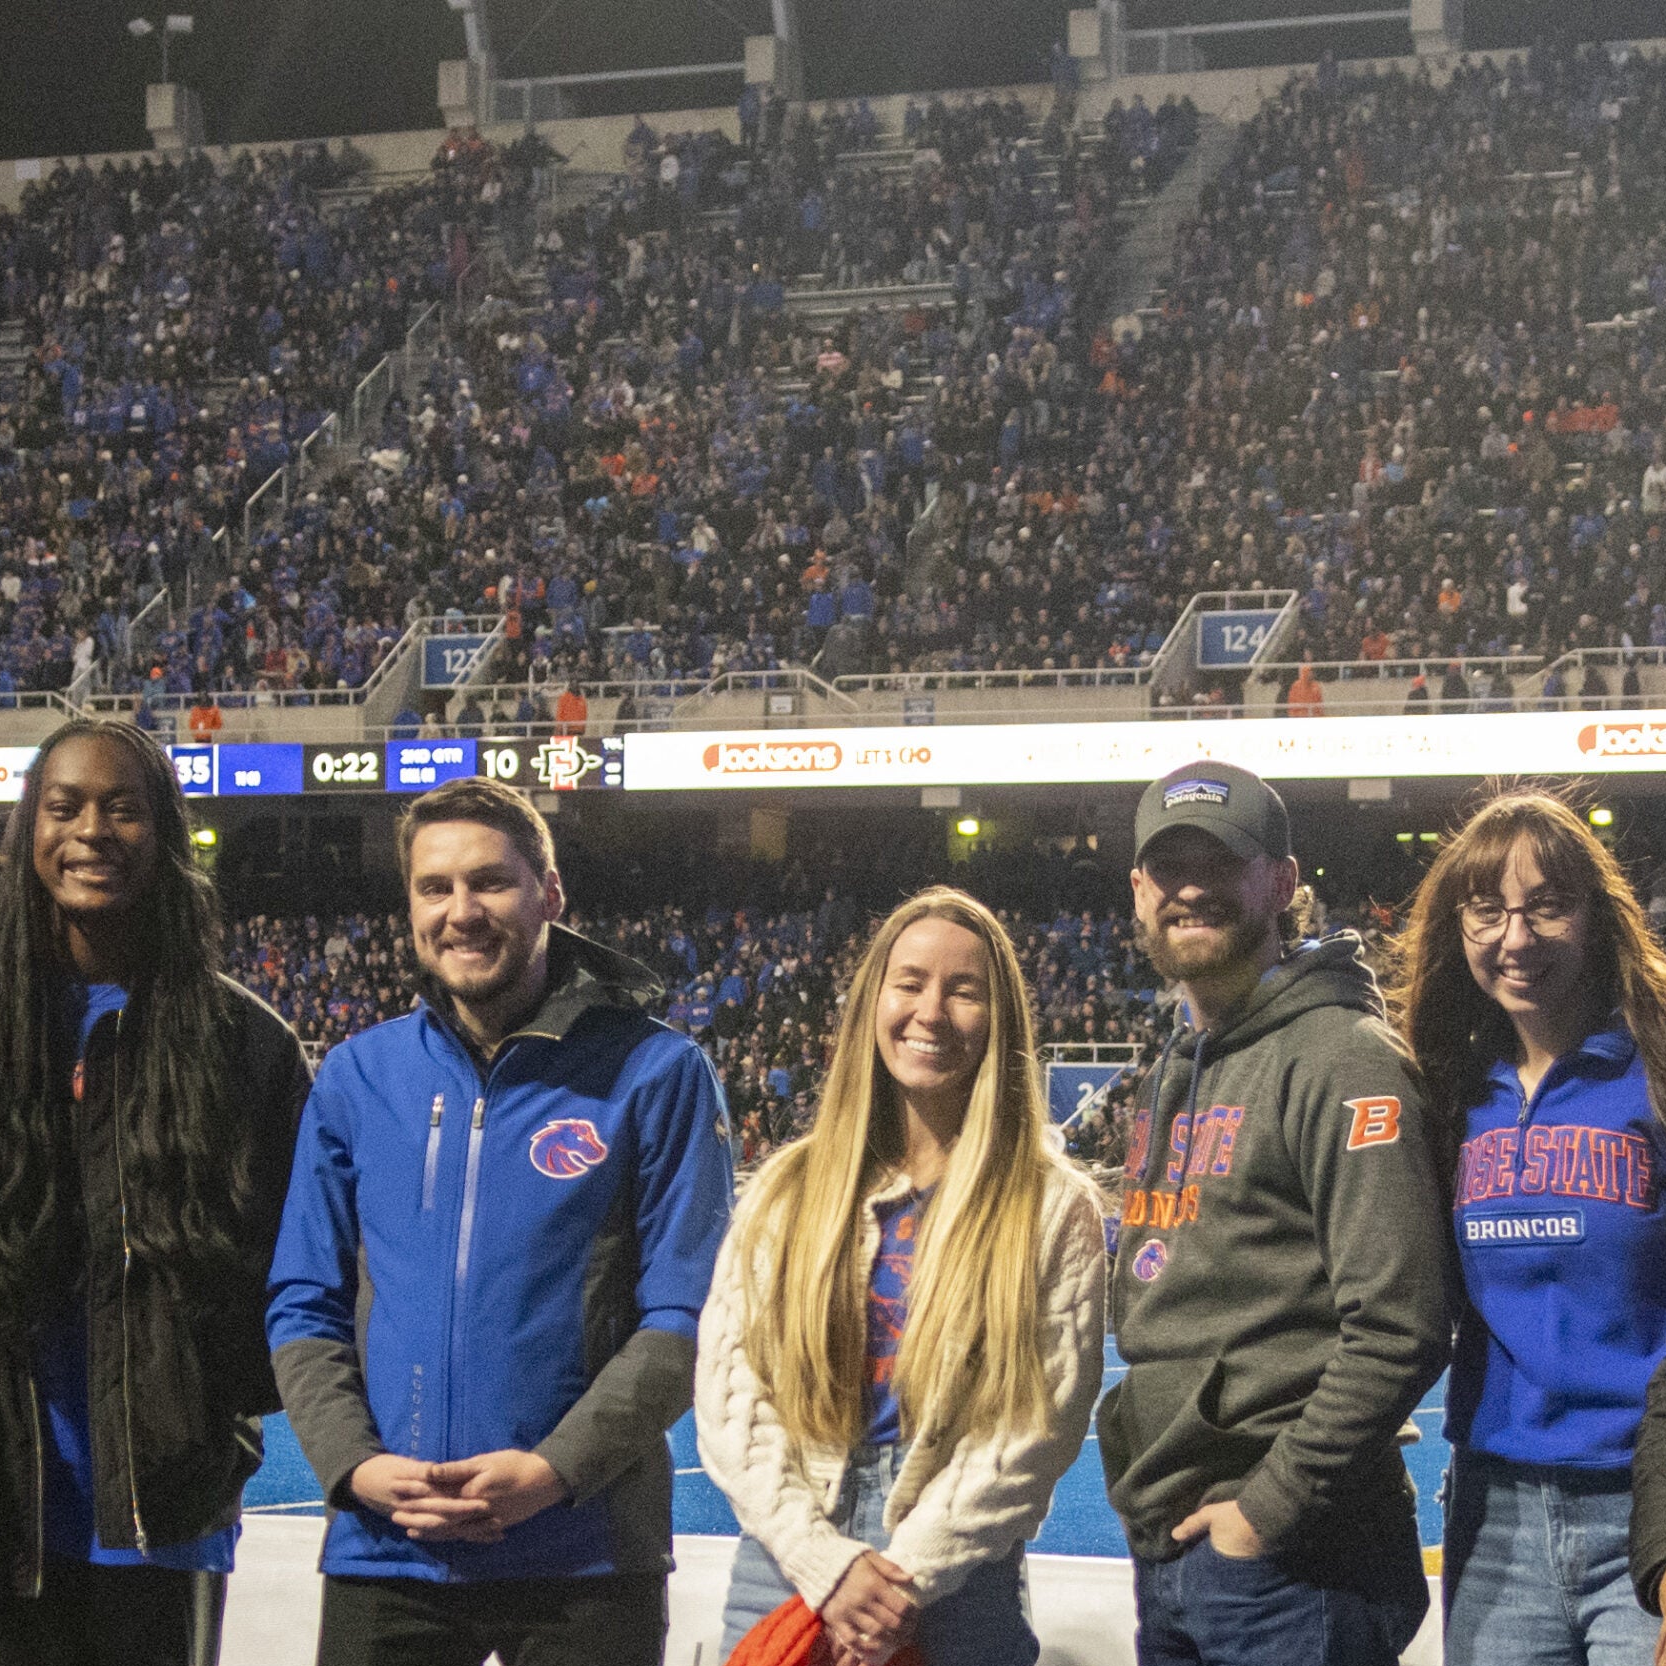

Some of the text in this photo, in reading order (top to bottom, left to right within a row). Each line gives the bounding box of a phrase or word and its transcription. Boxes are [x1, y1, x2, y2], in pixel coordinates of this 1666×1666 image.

[312, 752, 379, 783] 0:22
[483, 749, 519, 779] 10
[709, 742, 837, 773] Jacksons
[1165, 793, 1223, 808] patagonia
[1342, 1095, 1401, 1151] B
[1521, 1124, 1655, 1209] STATE
[1465, 1217, 1580, 1241] BRONCOS
